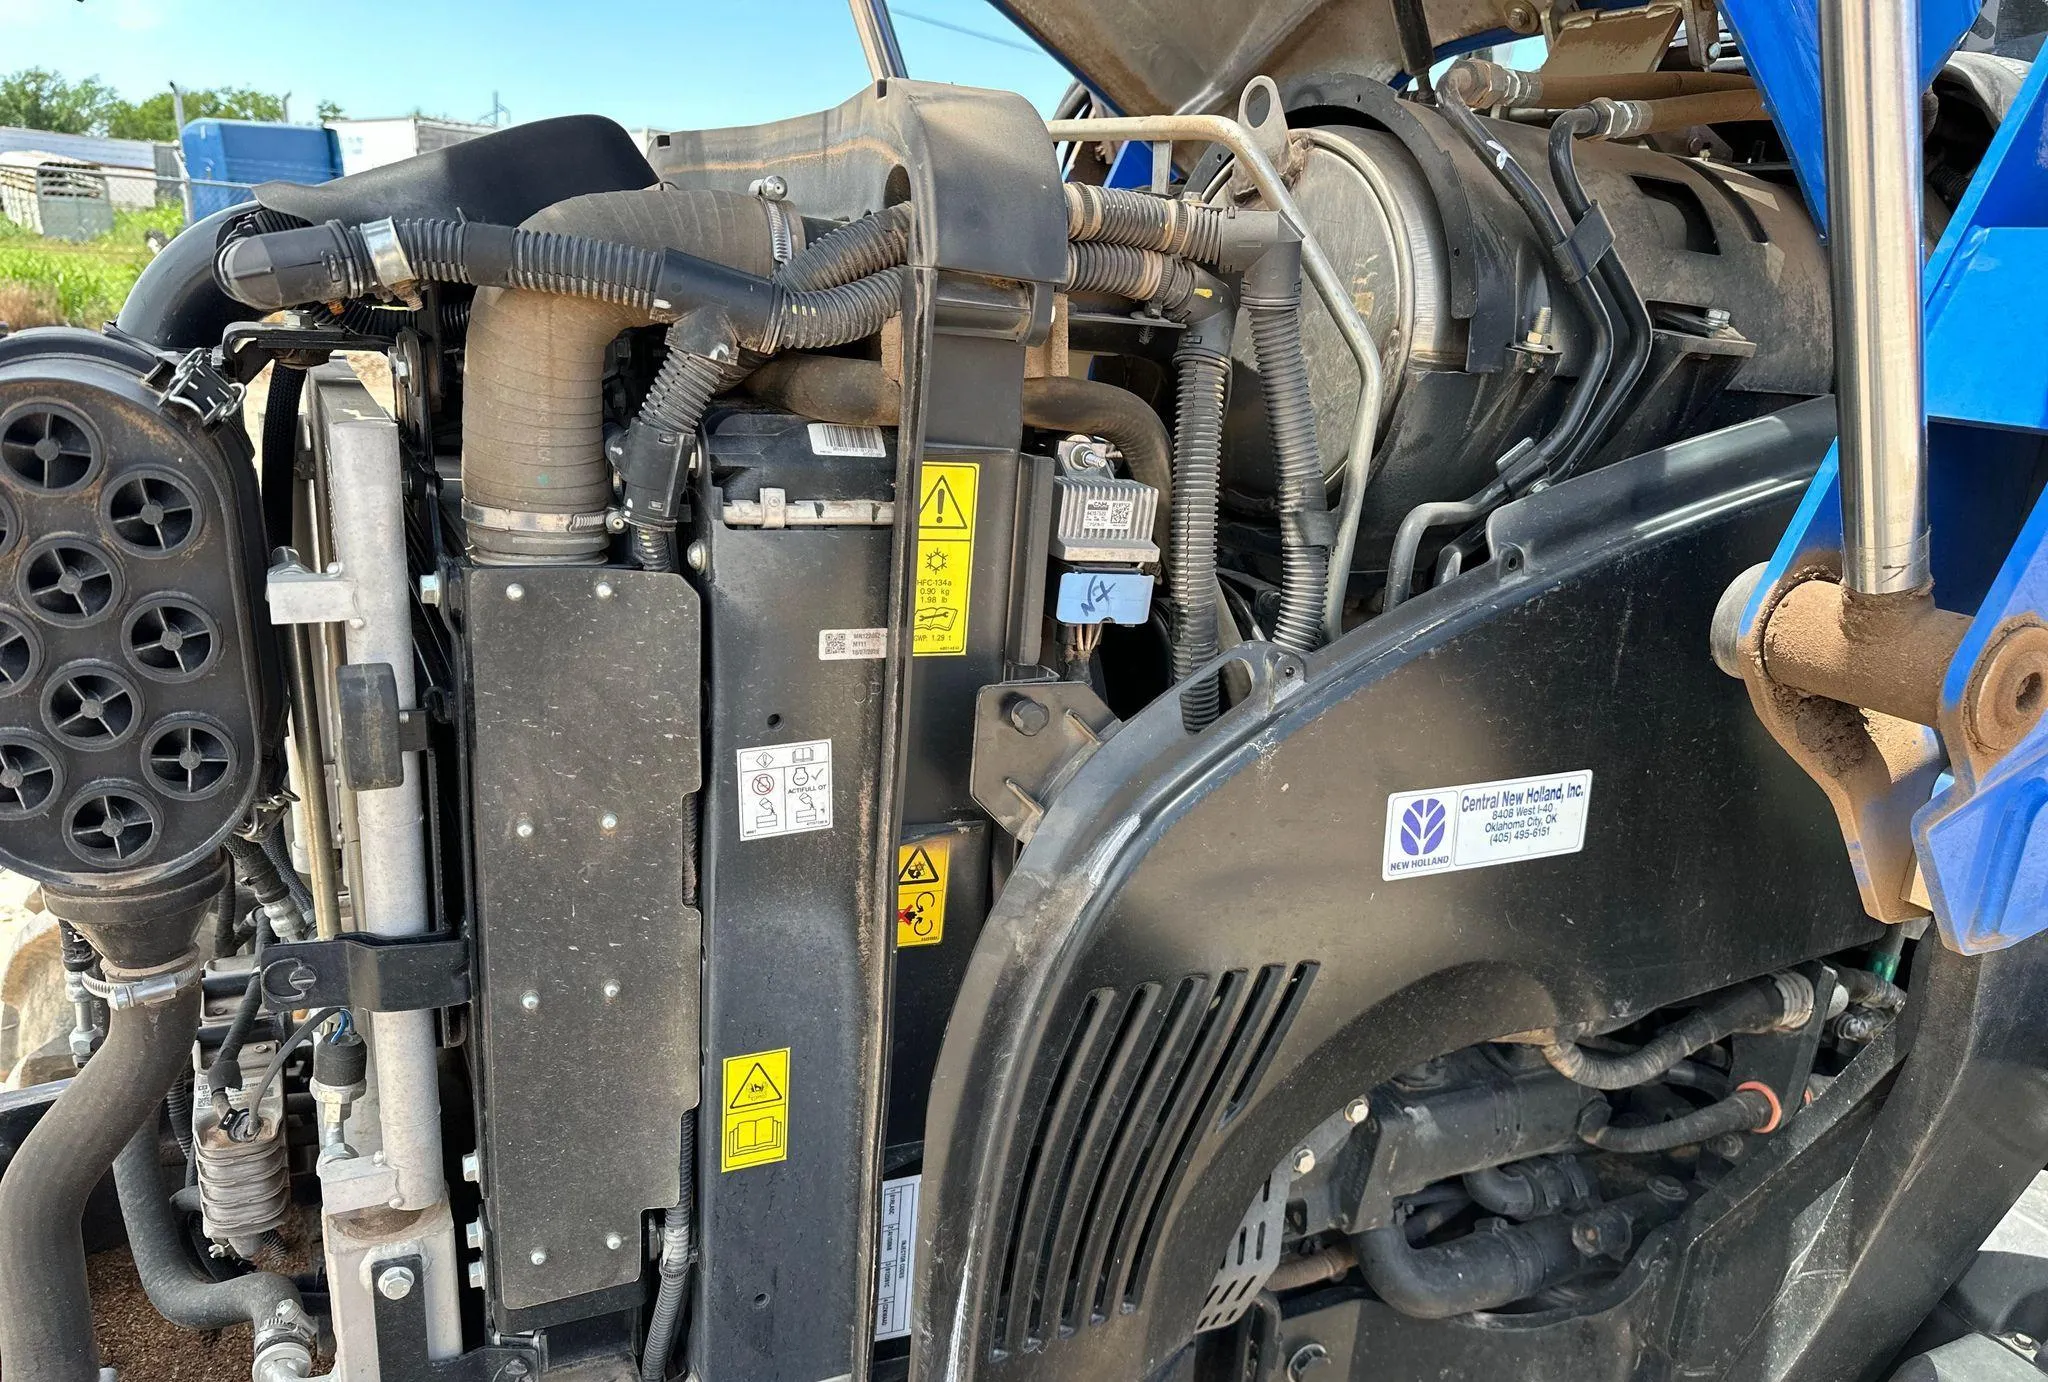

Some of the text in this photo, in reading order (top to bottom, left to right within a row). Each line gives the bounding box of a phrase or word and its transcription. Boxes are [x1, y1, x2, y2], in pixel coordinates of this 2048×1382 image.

[916, 579, 952, 587] HFC-134a
[941, 588, 950, 596] kg
[788, 786, 816, 794] ACTIFULL
[1461, 783, 1584, 812] Central New Holland, Inc.
[1492, 803, 1554, 821] 8408 West I-40
[1484, 813, 1558, 834] Oklahoma City, OK
[1489, 827, 1550, 846] (405) 495-6151
[1390, 855, 1450, 872] NEW HOLLAND
